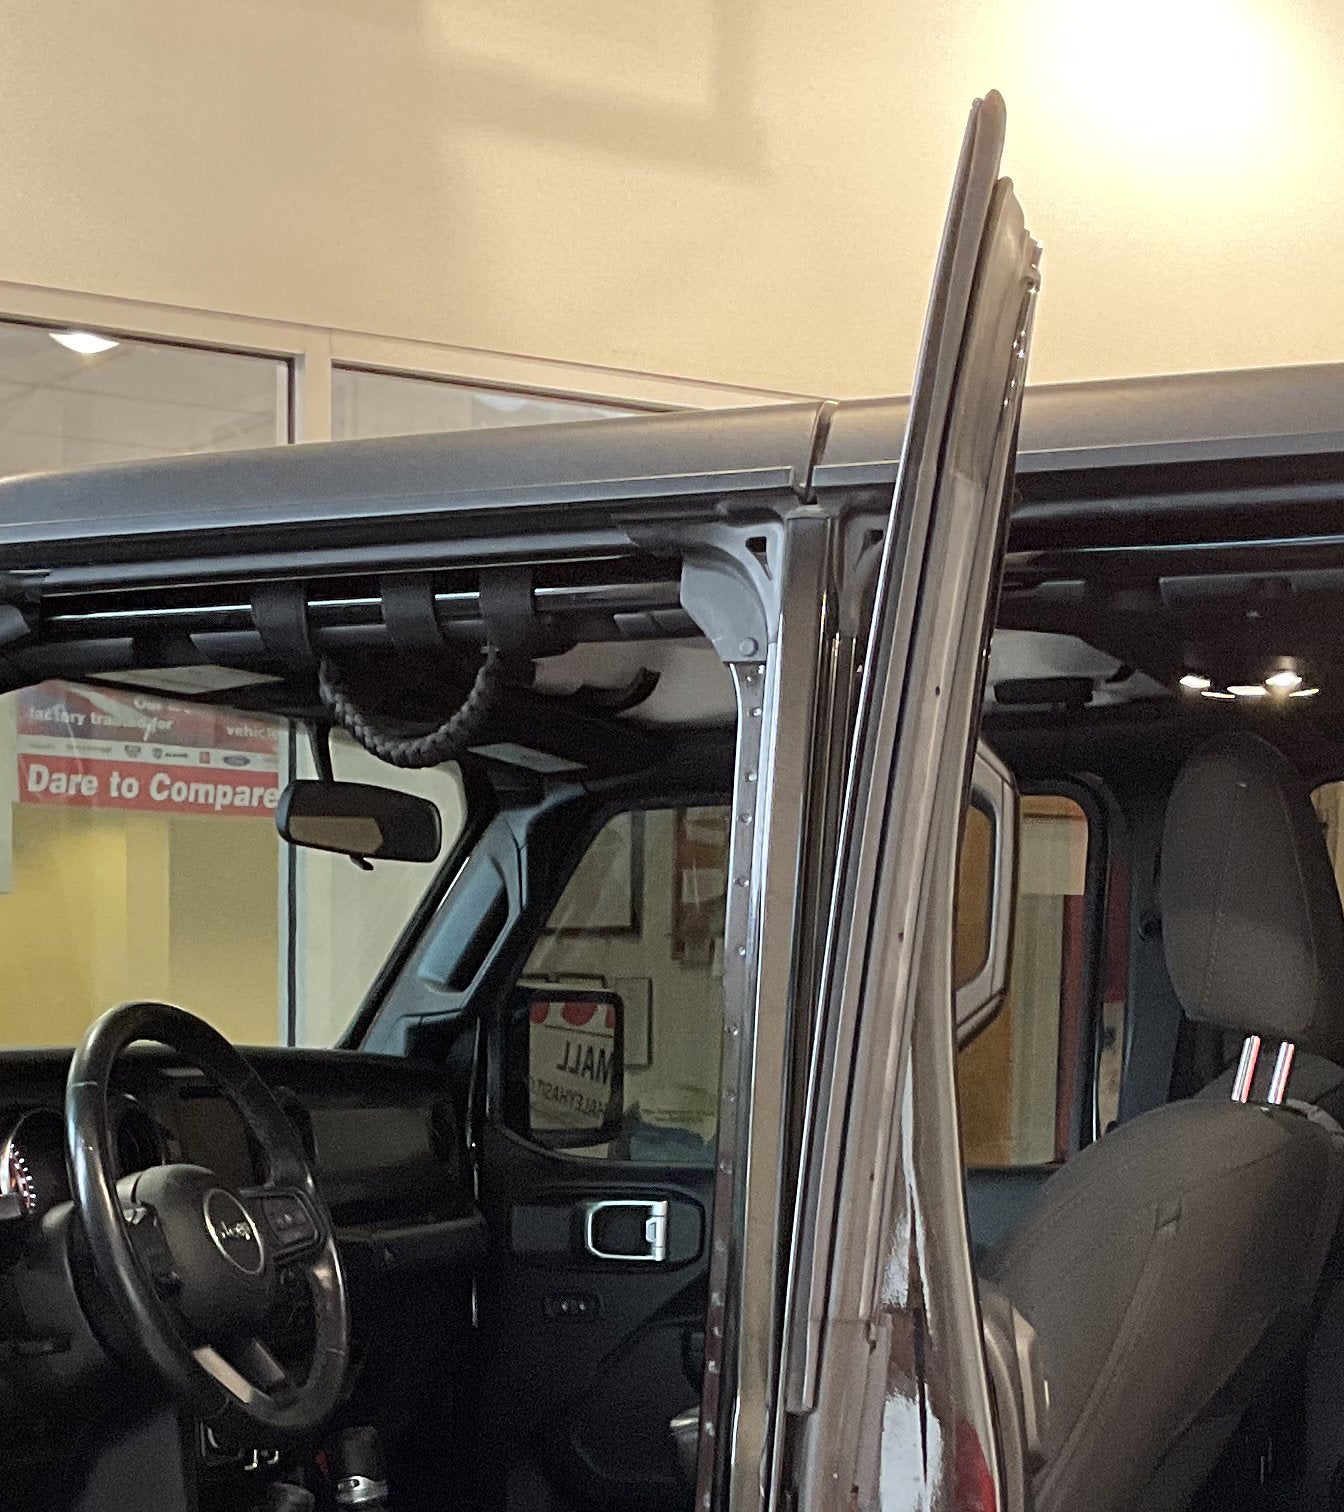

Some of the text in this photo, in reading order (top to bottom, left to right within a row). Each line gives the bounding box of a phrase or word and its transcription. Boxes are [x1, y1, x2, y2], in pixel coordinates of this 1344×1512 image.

[28, 763, 280, 811] Dare to Compare
